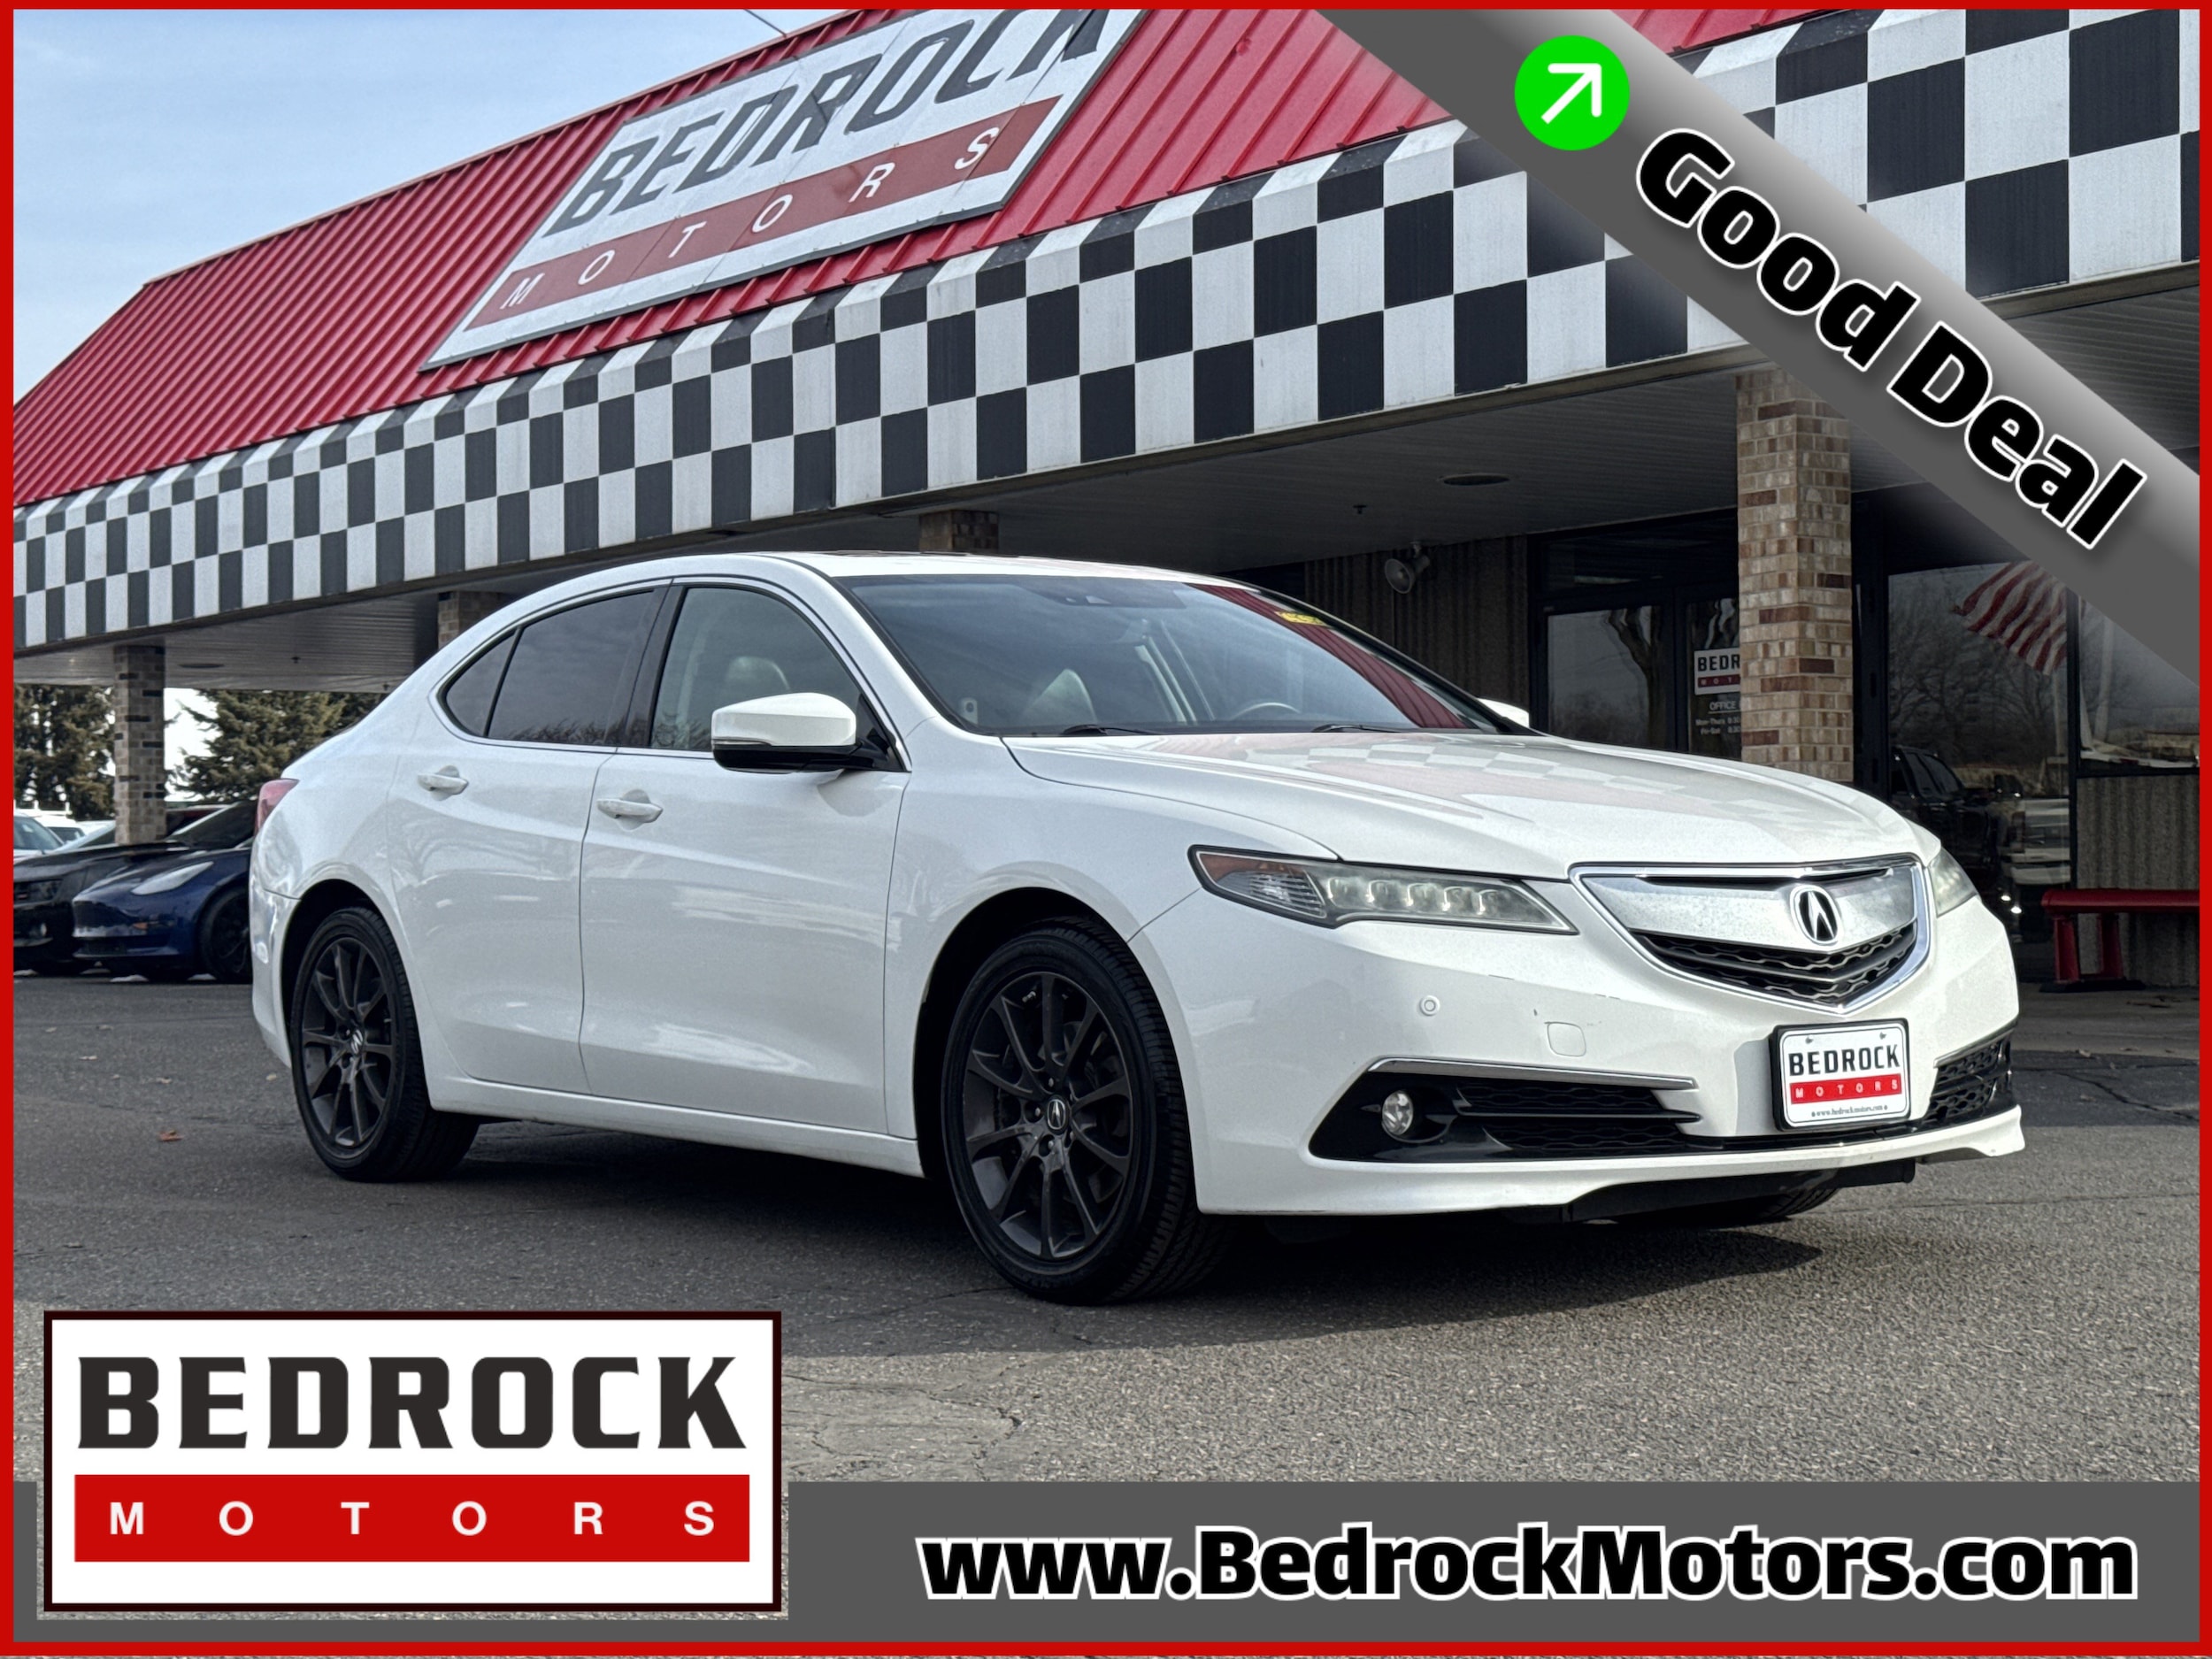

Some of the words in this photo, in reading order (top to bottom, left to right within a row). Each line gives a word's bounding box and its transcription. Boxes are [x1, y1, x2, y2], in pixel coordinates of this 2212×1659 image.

[542, 11, 1108, 237] BEDROCK
[501, 127, 1001, 310] MOTORS
[1709, 701, 1737, 710] OFFICE
[1788, 1044, 1900, 1076] BEDROCK
[1795, 1079, 1898, 1098] MOTORS
